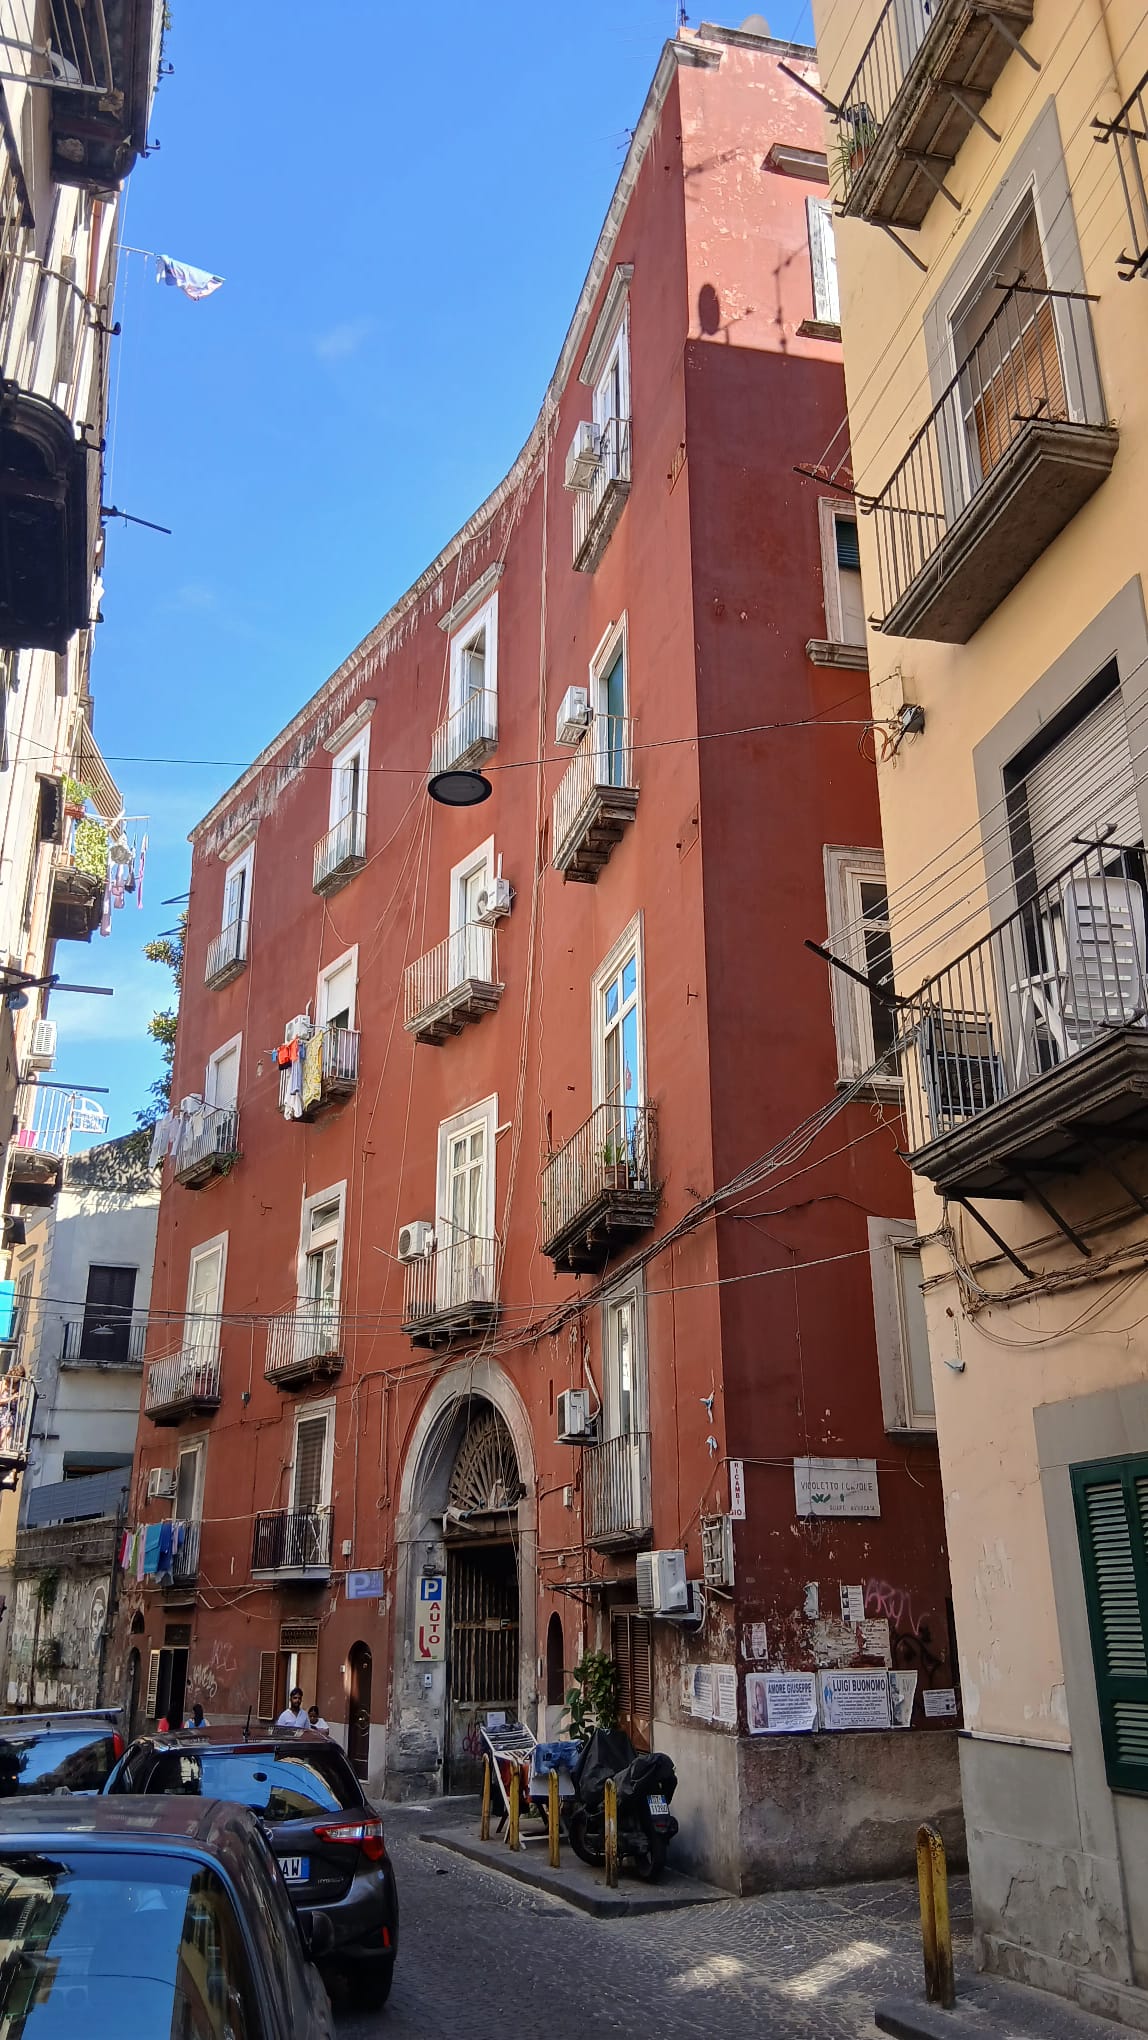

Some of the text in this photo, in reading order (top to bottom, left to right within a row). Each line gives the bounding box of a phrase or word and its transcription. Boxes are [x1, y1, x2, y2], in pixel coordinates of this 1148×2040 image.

[801, 1481, 838, 1491] VICOLETTO
[424, 1580, 438, 1599] P
[429, 1602, 440, 1644] AUTO
[768, 1682, 812, 1694] AMORE GIUSEPPE
[833, 1680, 886, 1692] LUIGI BUONOMO
